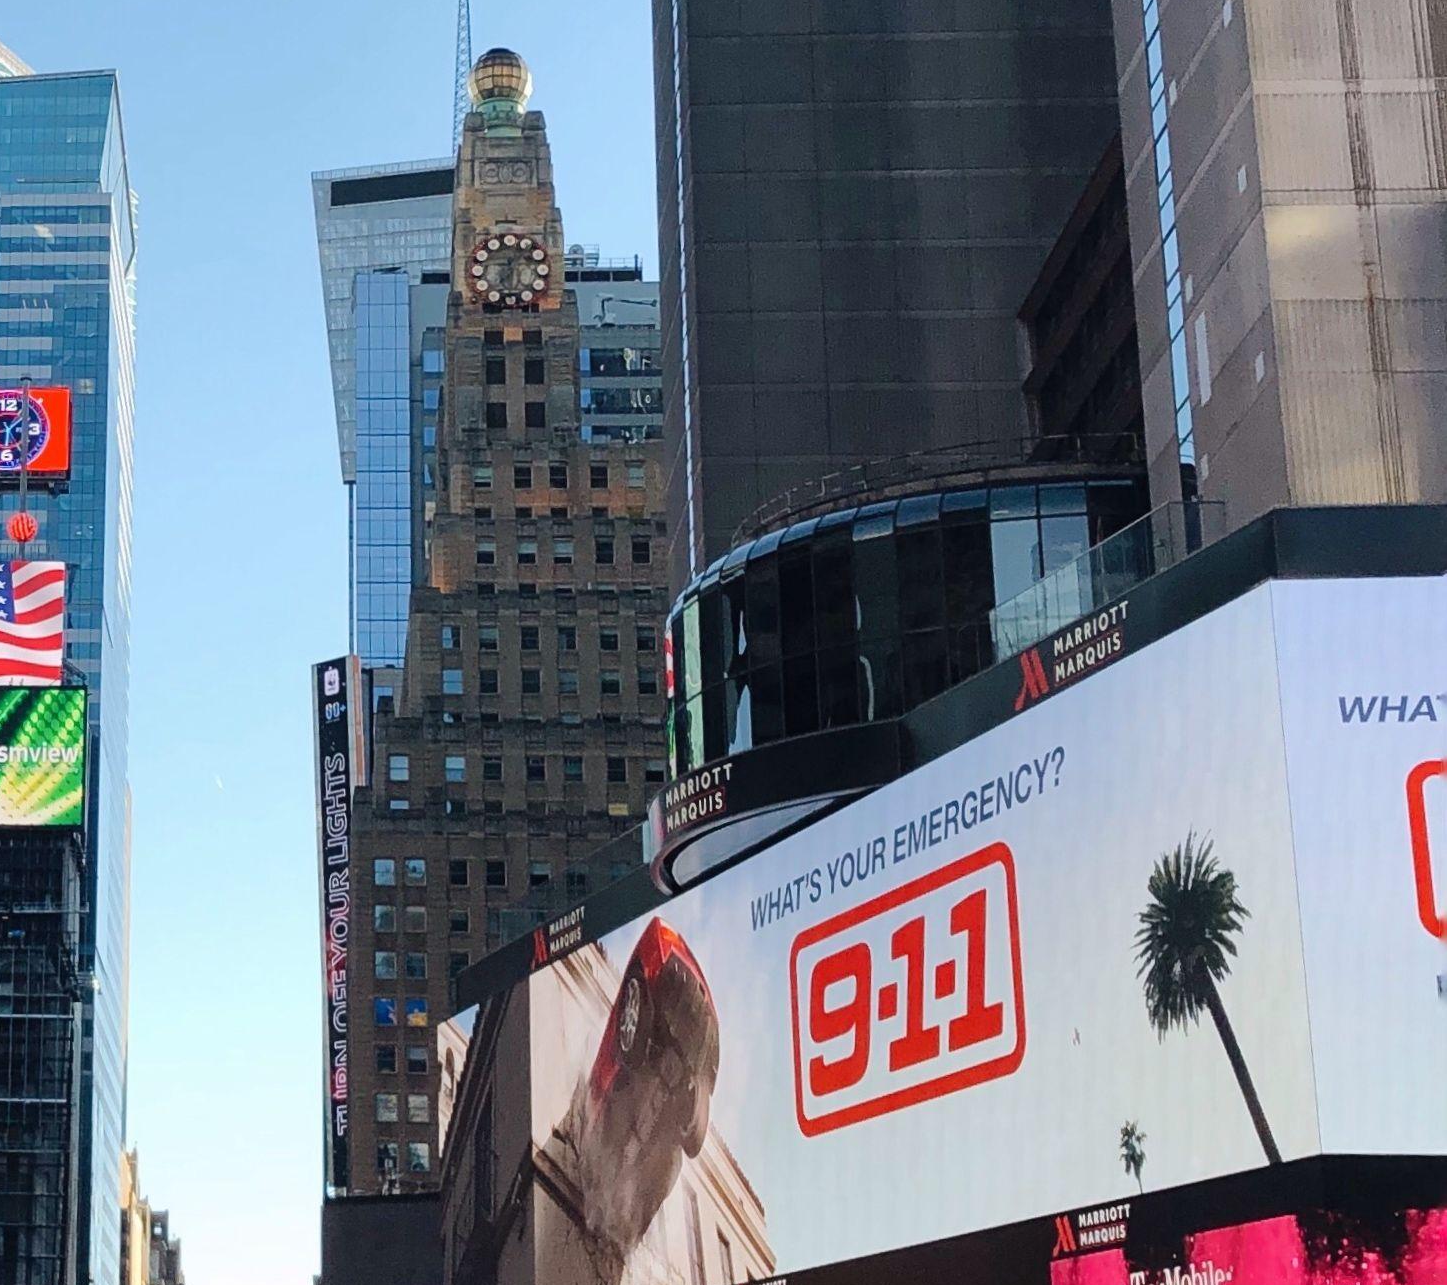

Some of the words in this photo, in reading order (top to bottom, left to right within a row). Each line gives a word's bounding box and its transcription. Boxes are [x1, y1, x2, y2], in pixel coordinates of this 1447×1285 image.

[0, 400, 18, 411] 12
[28, 423, 40, 435] 3
[1, 449, 13, 461] 6
[1053, 600, 1129, 656] MARRIOTT
[1054, 630, 1123, 684] MARQUIS
[1338, 694, 1447, 724] WHA
[664, 763, 733, 809] MARRIOTT
[325, 752, 349, 865] LIGHTS
[666, 790, 724, 833] MARQUIS
[751, 864, 823, 932] WHAT'S
[825, 836, 887, 892] YOUR
[893, 747, 1066, 864] EMERGENCY?
[549, 905, 586, 936] MARRIOTT
[550, 925, 583, 954] MARQUIS
[1077, 1203, 1131, 1228] MARRIOTT
[1079, 1225, 1127, 1247] MARQUIS
